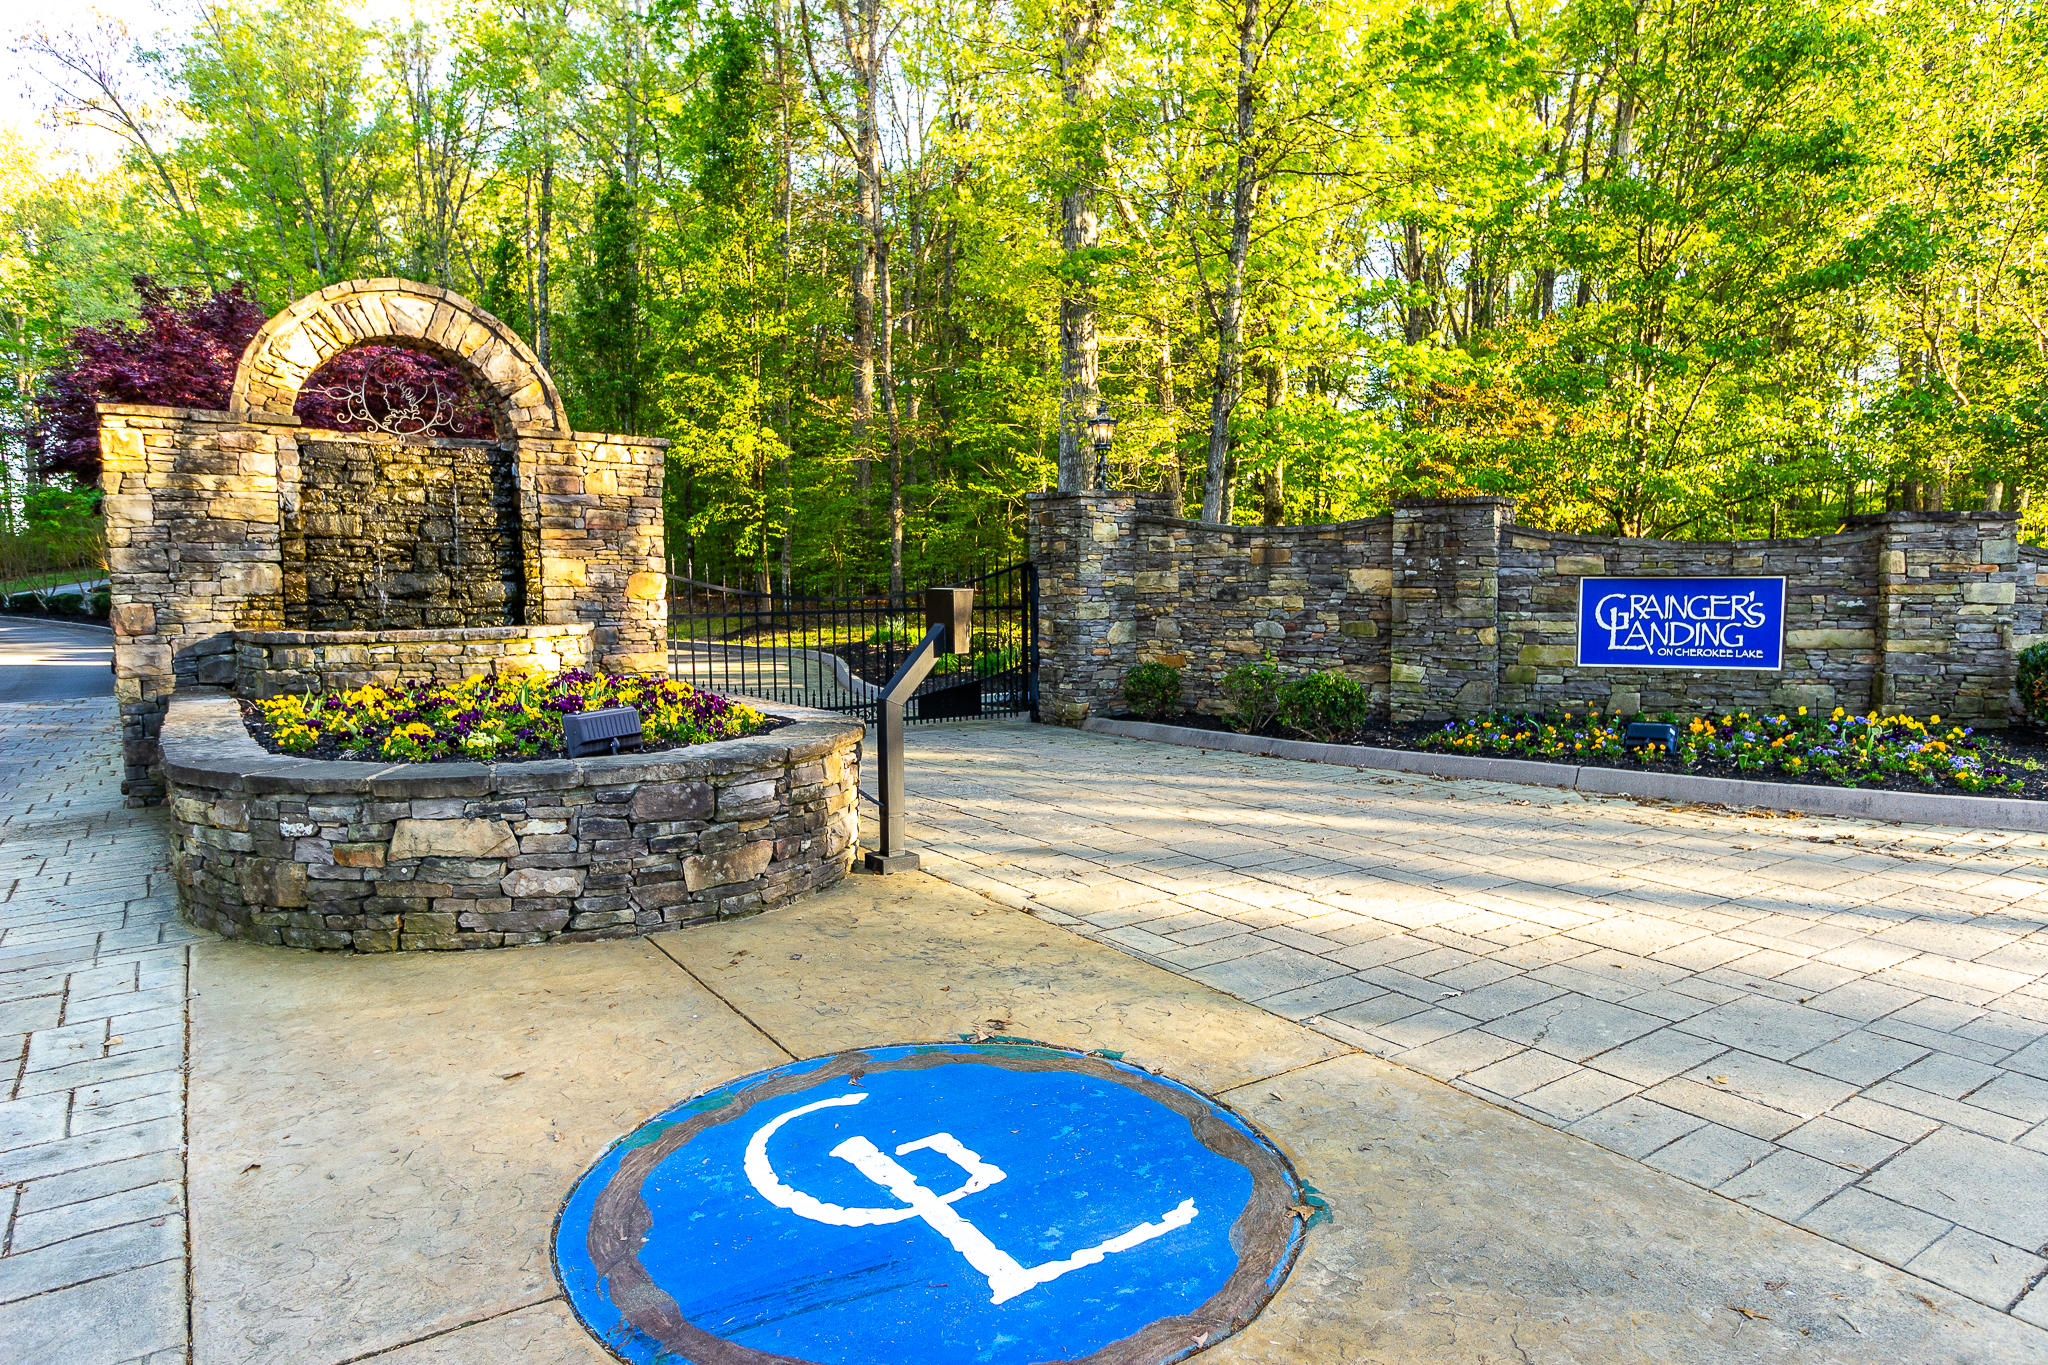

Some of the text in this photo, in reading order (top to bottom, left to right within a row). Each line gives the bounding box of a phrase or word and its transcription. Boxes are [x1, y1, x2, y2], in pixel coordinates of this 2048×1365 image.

[1595, 590, 1766, 630] GRAINGER'S
[1607, 606, 1744, 655] LANDING
[1657, 648, 1764, 659] ON CHEROKEE LAKE
